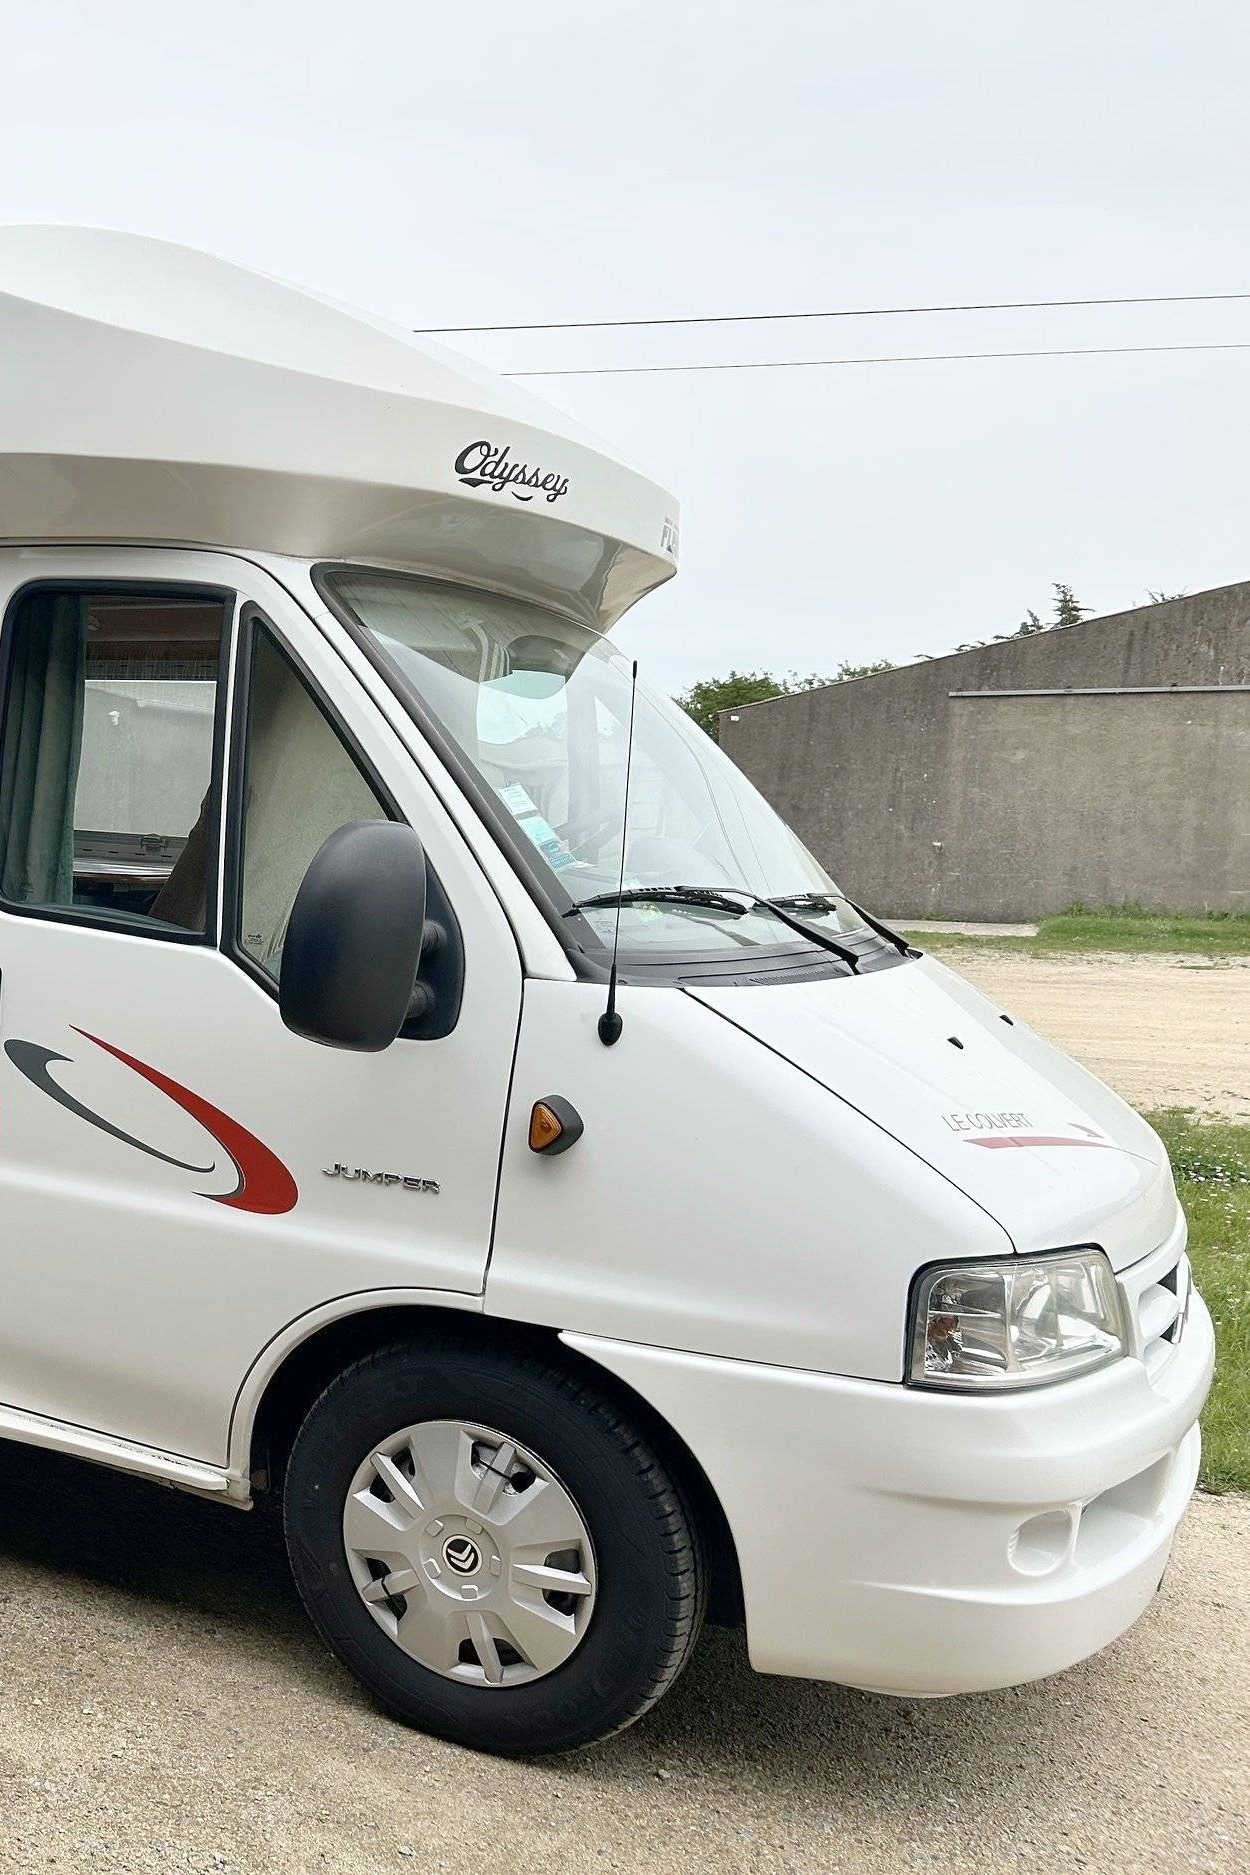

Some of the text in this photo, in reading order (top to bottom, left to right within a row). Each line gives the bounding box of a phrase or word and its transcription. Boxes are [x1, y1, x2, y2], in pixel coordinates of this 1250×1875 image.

[454, 440, 570, 503] Odyssey
[941, 1111, 1034, 1132] LE COLVERT
[320, 1161, 441, 1195] JUMPER
